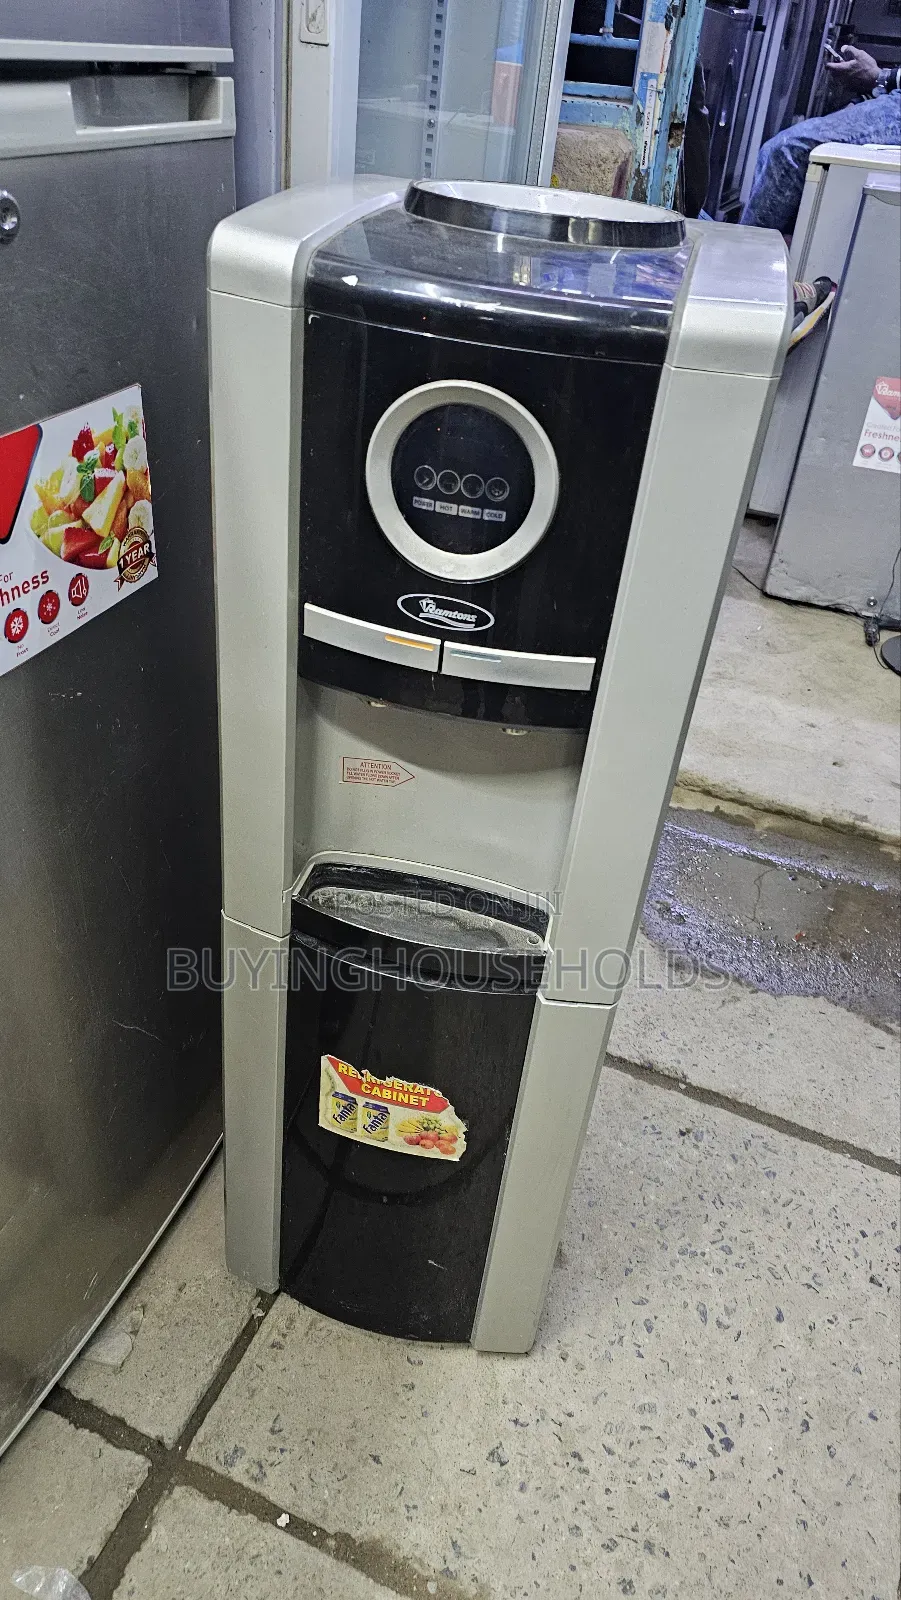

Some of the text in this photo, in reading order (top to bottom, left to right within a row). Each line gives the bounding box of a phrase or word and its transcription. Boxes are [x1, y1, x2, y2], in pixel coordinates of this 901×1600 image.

[413, 498, 433, 508] POWER
[439, 504, 453, 512] HOT
[460, 507, 480, 517] WARM
[485, 511, 503, 519] COLD
[118, 542, 151, 569] 1 YEAR
[421, 599, 478, 623] Ramtons
[360, 762, 392, 771] ATTENTION
[360, 1083, 430, 1107] CABINET
[332, 1101, 358, 1126] Fanta
[362, 1110, 389, 1136] Fanta
